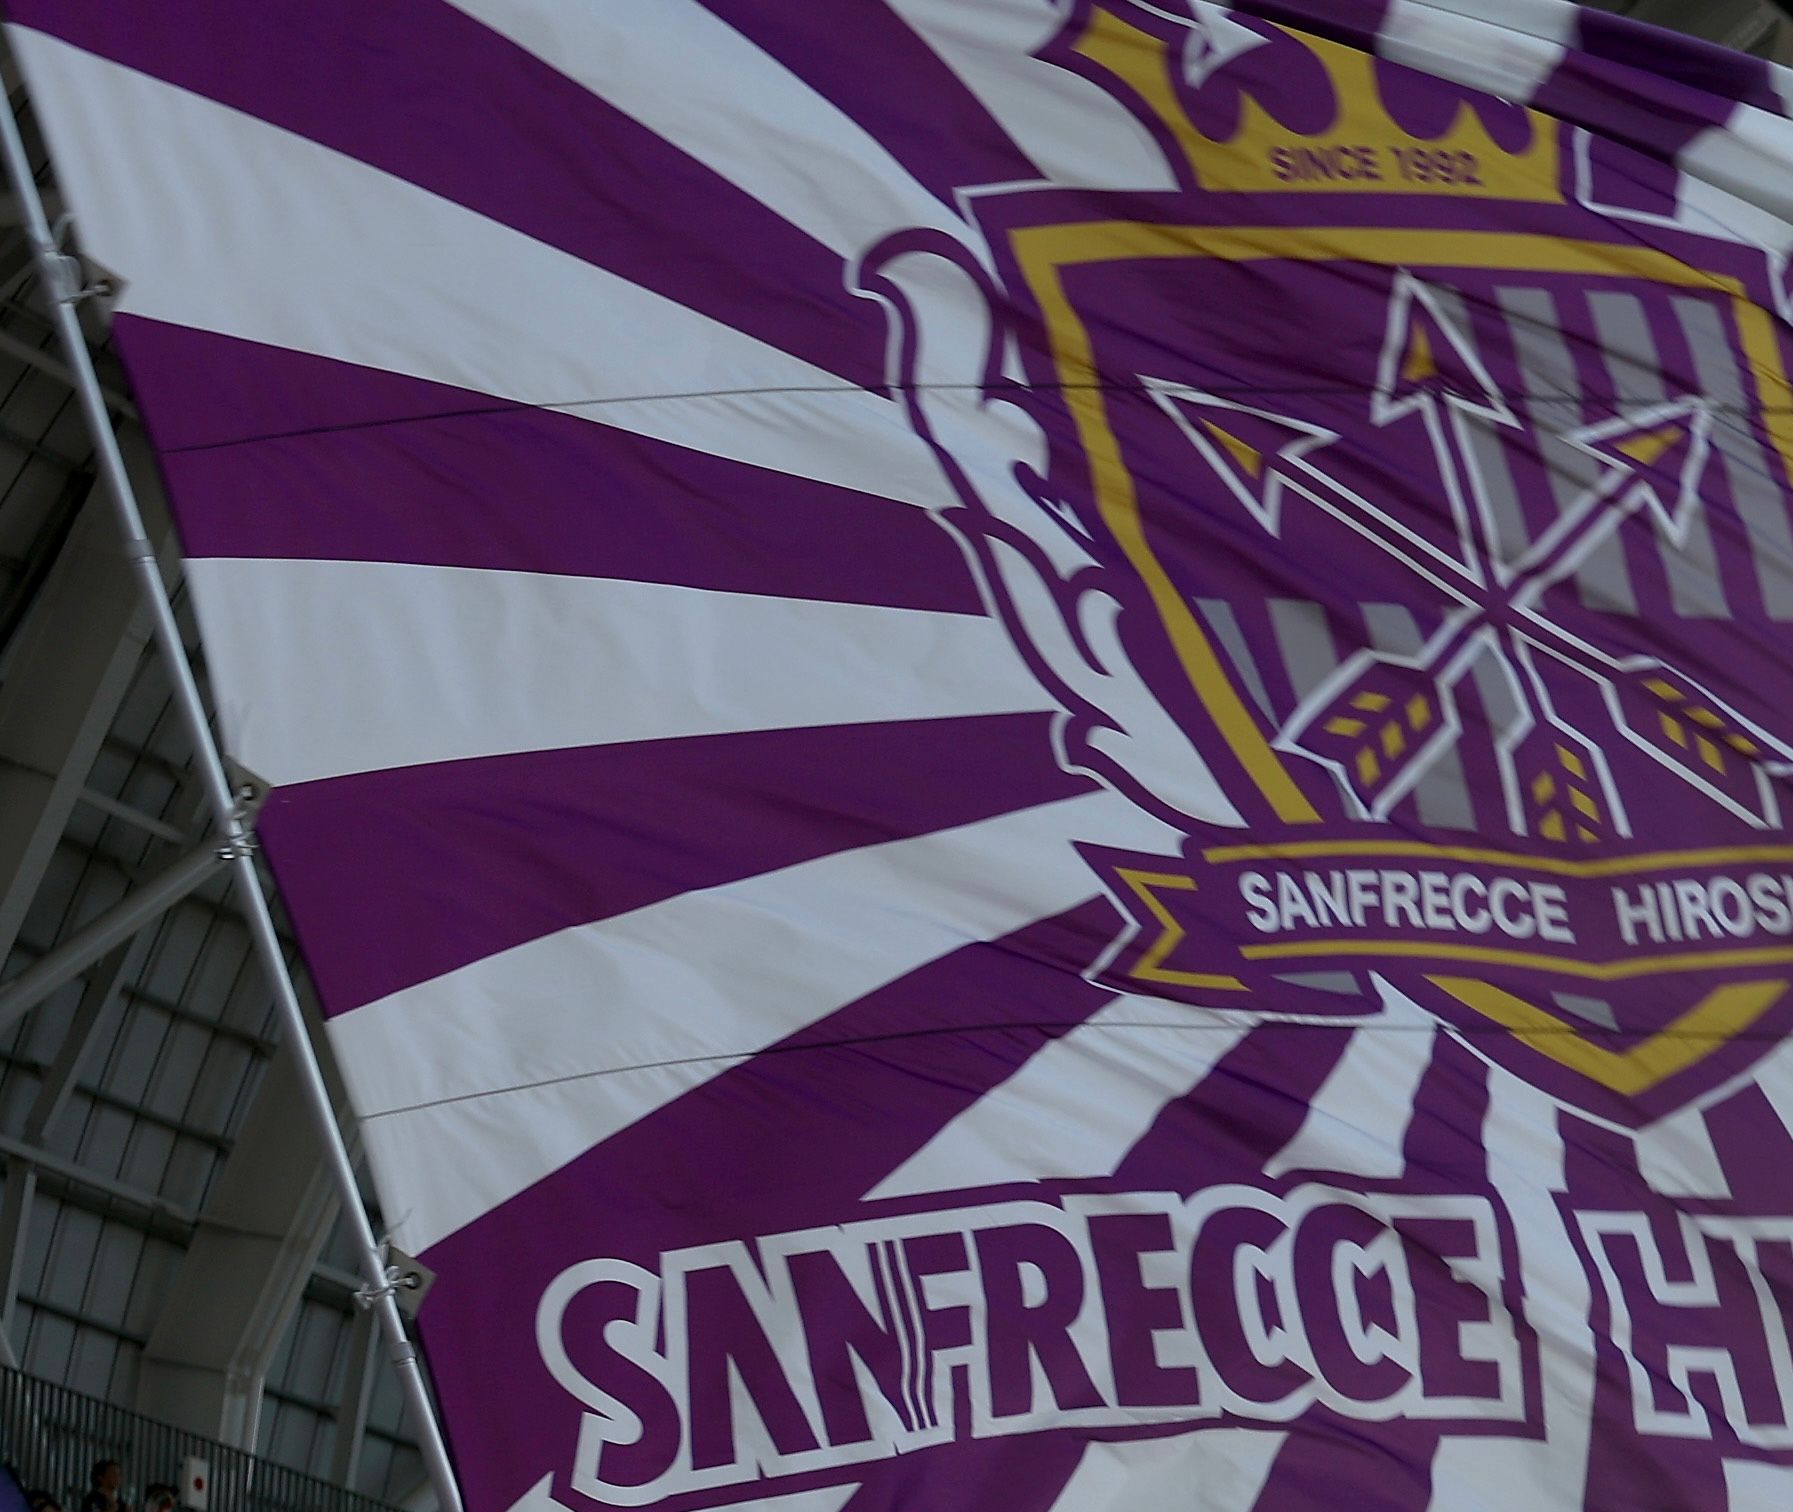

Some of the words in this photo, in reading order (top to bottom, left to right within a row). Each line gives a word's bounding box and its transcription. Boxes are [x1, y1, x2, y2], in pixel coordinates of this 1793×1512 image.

[1270, 145, 1383, 184] SINCE
[1392, 146, 1483, 187] 1992
[1240, 870, 1575, 943] SANFRECCE
[537, 1184, 1535, 1506] SANFRECCE
